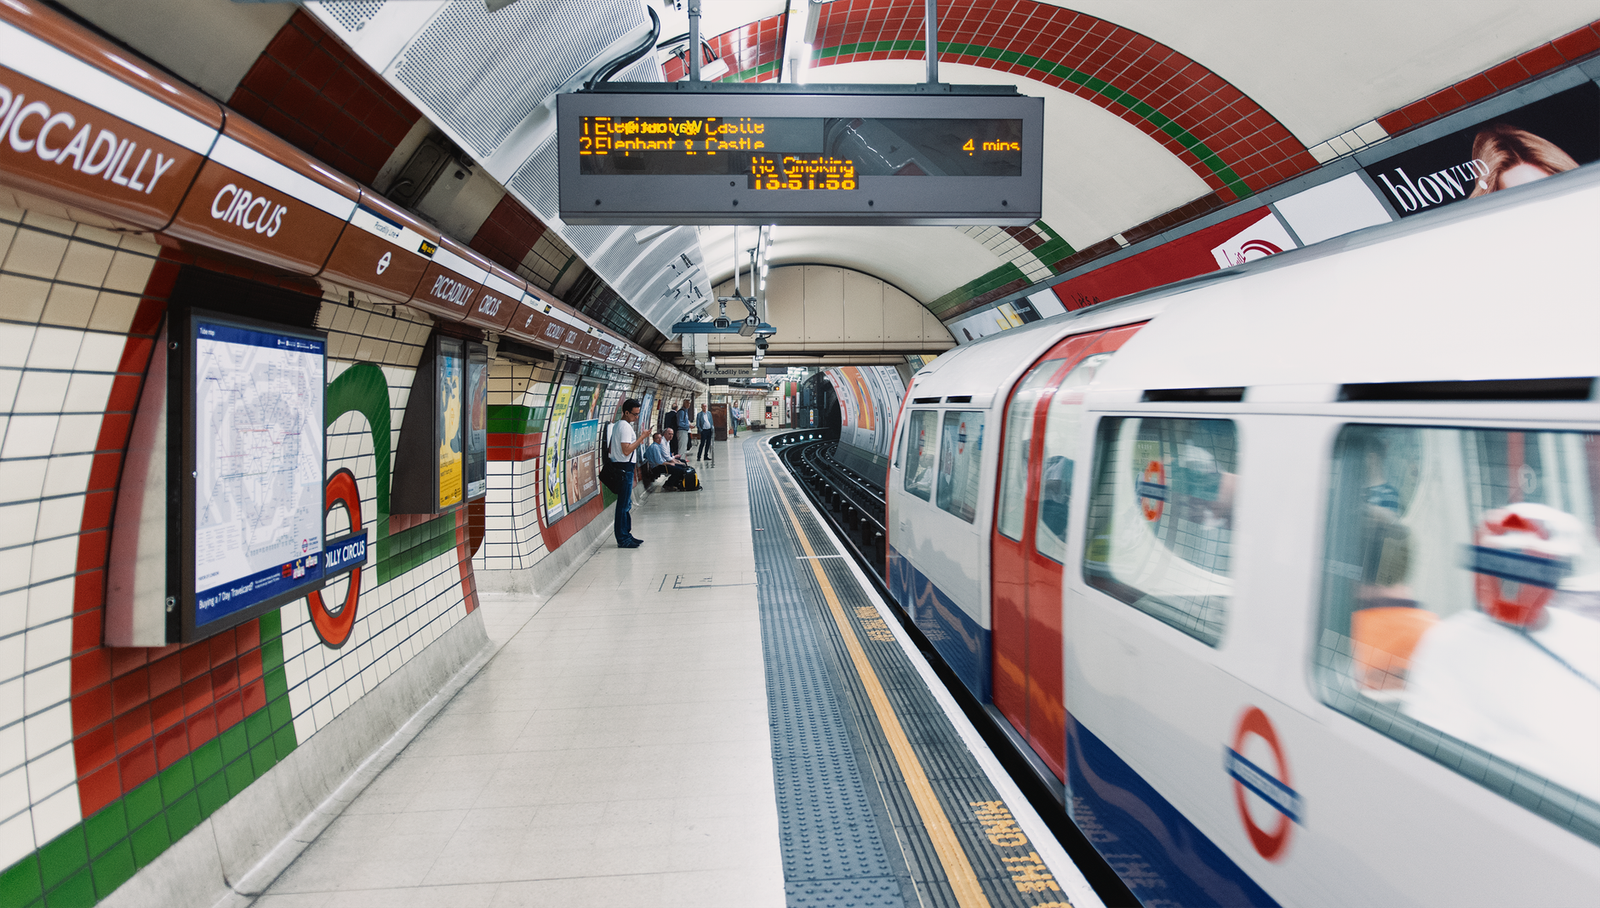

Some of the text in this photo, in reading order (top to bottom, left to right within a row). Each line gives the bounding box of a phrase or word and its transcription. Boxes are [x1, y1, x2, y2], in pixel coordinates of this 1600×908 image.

[704, 116, 765, 136] Castle
[704, 137, 765, 155] Castle
[962, 138, 975, 156] 4
[982, 138, 1021, 153] mins
[751, 156, 855, 176] No Smoking
[210, 183, 288, 238] CIRCUS
[430, 274, 502, 317] PICCADILLY CIRCUS
[342, 540, 365, 562] CIRCUS
[198, 597, 215, 610] Buying
[221, 590, 231, 602] Day
[969, 800, 1028, 848] MIND
[1001, 851, 1061, 893] THE
